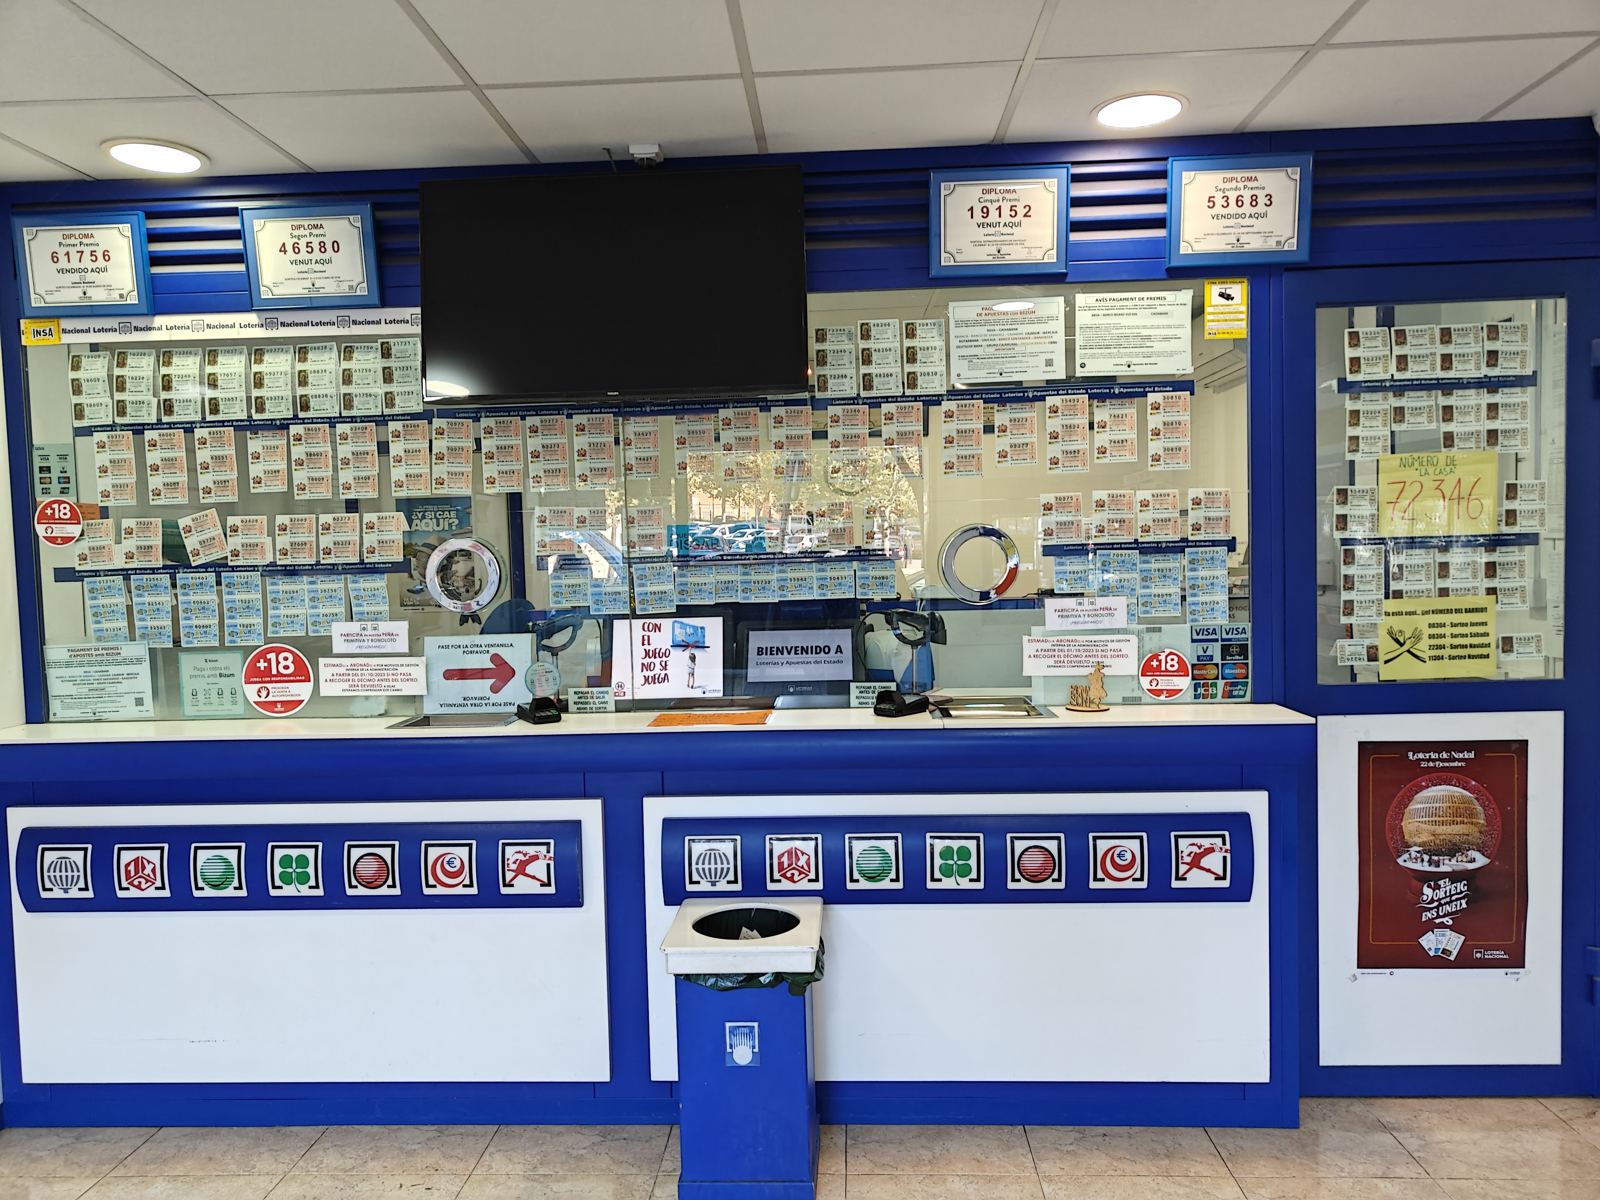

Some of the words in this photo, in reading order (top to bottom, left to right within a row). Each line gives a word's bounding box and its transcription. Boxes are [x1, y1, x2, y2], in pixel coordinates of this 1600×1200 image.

[1207, 194, 1273, 208] 53683
[968, 205, 1031, 219] 19152
[1003, 220, 1021, 228] AQUÍ
[279, 241, 340, 254] 46580
[51, 250, 110, 263] 61756
[315, 257, 332, 265] AQUÍ
[206, 322, 236, 330] Nacional
[32, 329, 53, 338] INSA
[1400, 455, 1438, 468] NÚMERO
[1446, 455, 1457, 466] DE
[45, 504, 71, 519] +18
[642, 622, 661, 633] CON
[1195, 628, 1217, 636] VISA
[1224, 627, 1247, 635] VISA
[642, 635, 651, 646] EL
[641, 648, 670, 660] JUEGO
[757, 645, 831, 656] BIENVENIDO
[835, 645, 843, 654] A
[1202, 646, 1208, 654] V
[256, 652, 294, 675] +18
[641, 662, 655, 672] NO
[659, 660, 669, 671] SE
[1151, 652, 1178, 671] +18
[641, 673, 669, 686] JUEGA
[1438, 878, 1451, 888] EL
[1422, 909, 1437, 921] ENS
[1439, 898, 1468, 915] UNEIX
